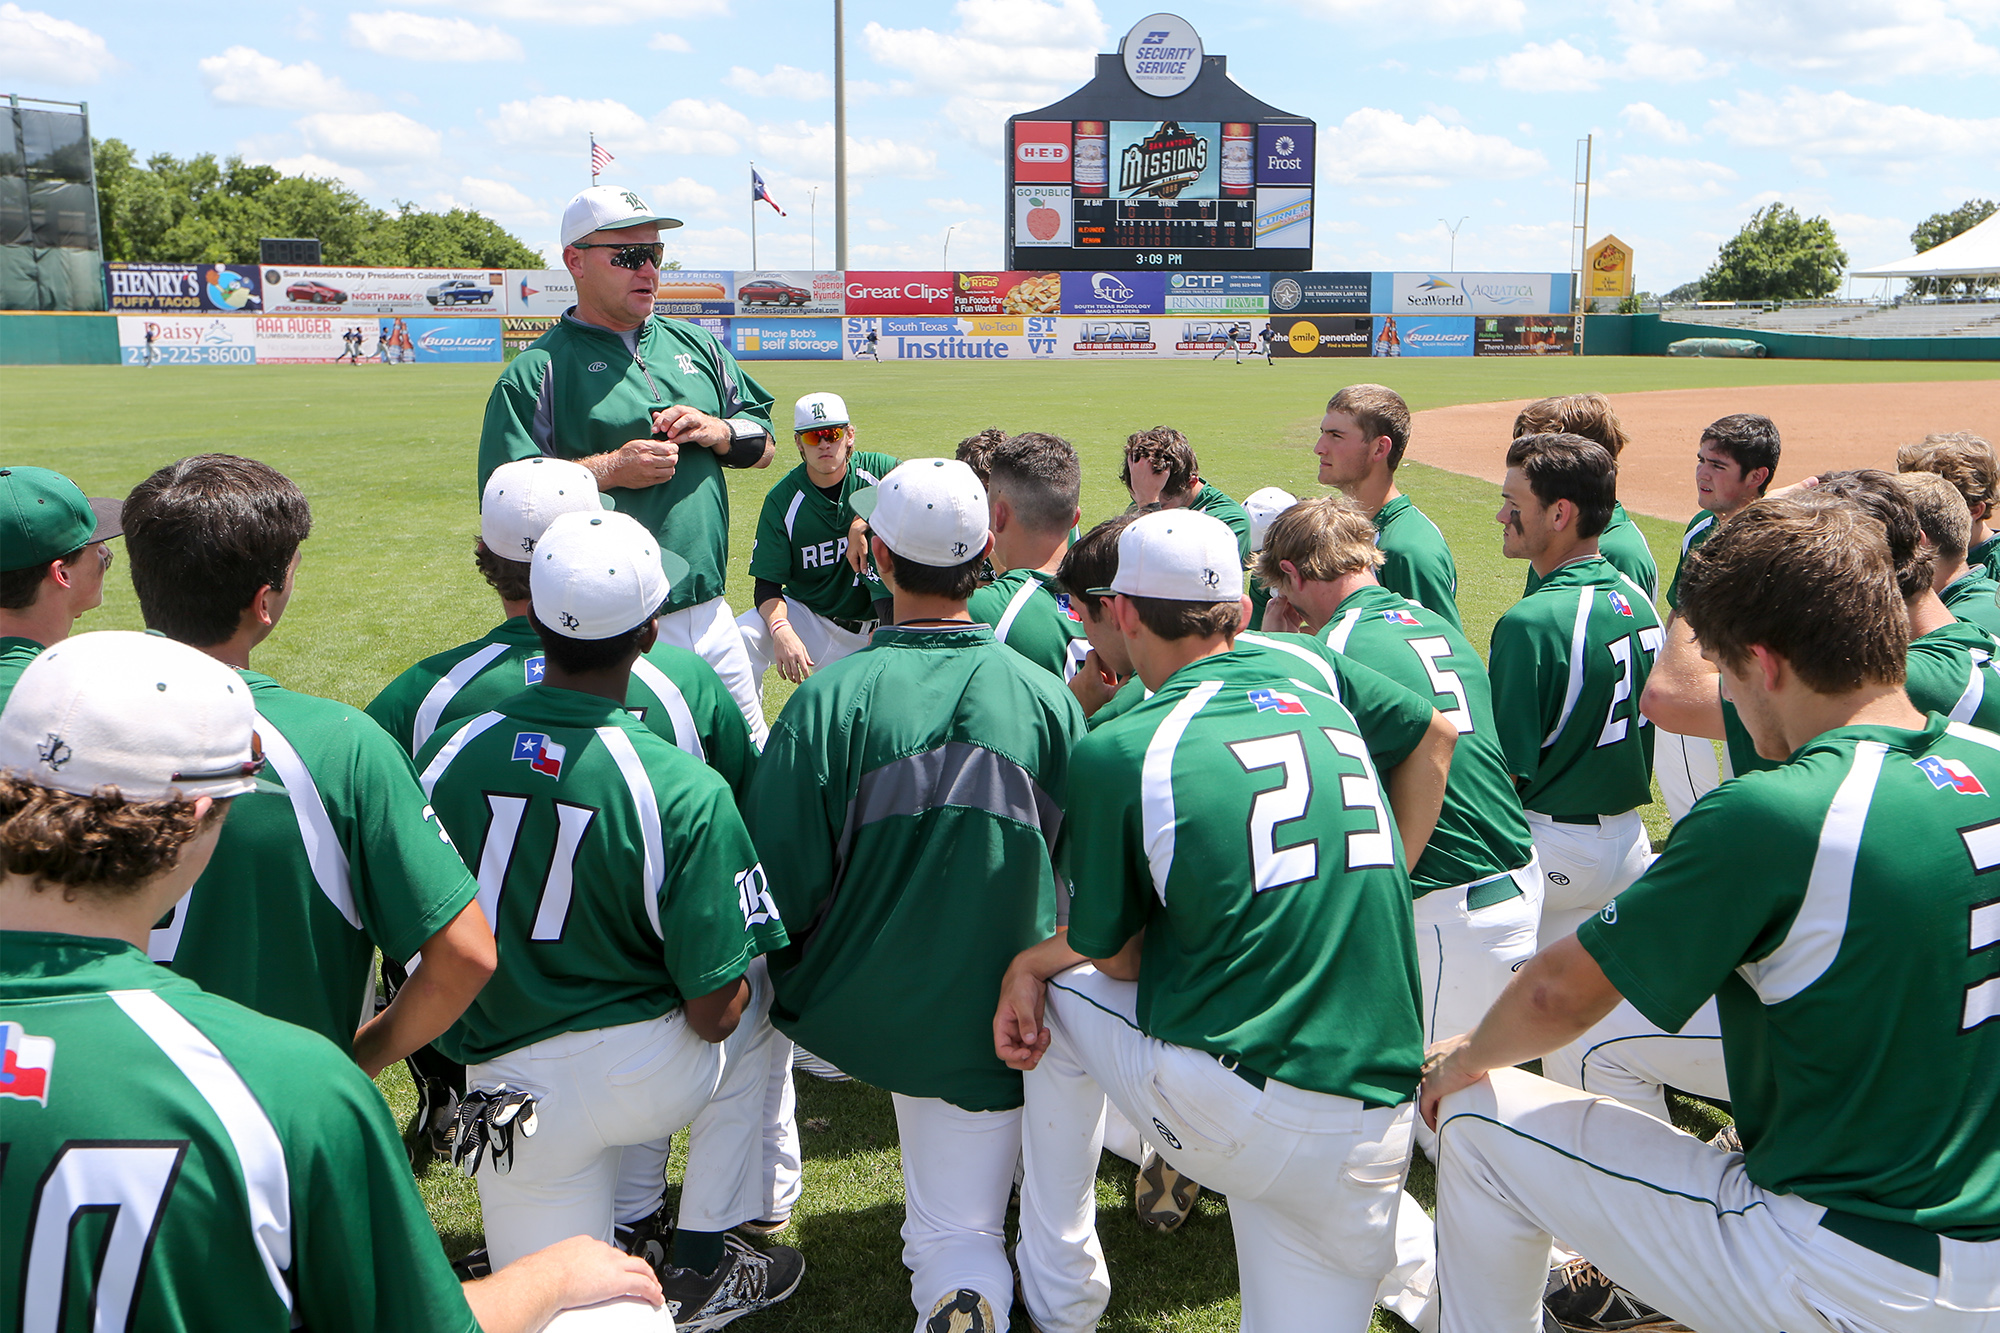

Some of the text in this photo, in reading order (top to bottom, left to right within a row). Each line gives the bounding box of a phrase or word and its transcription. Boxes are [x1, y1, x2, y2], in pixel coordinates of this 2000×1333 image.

[1136, 48, 1196, 60] SECURITY
[1136, 62, 1186, 74] SERVICE
[1149, 138, 1192, 150] SAN ANTONIO
[1122, 140, 1206, 188] MISSIONS
[1268, 156, 1302, 169] Frost
[620, 191, 648, 212] R
[1258, 204, 1309, 228] CORNER
[1136, 254, 1182, 265] 3:09 PM
[110, 270, 199, 296] HENRY'S
[813, 280, 843, 290] Superior
[1186, 275, 1224, 287] CTP
[813, 291, 842, 300] Hyundai
[846, 283, 949, 303] Great Clips
[1094, 286, 1134, 299] stric
[1472, 285, 1533, 297] AQUATICA
[113, 296, 200, 307] PUFFY TACOS
[1173, 297, 1264, 308] RENNERT TRAVEL
[1407, 295, 1463, 306] SeaWorld
[672, 304, 702, 314] BAIRD'S
[256, 318, 331, 333] AAA AUGER
[848, 317, 877, 333] ST
[888, 322, 1017, 331] South Texas Vo-Tech
[1028, 317, 1056, 332] ST
[144, 322, 204, 344] Daisy
[791, 329, 816, 338] Bob's
[1081, 322, 1150, 342] IPAC
[1274, 332, 1367, 344] the smile generation
[424, 337, 496, 346] BUD LIGHT
[762, 339, 838, 352] self storage
[898, 337, 1008, 358] Institute
[1028, 339, 1056, 354] VT
[128, 347, 251, 363] 210-225-8600
[674, 353, 699, 375] R
[812, 402, 827, 421] R
[1404, 634, 1475, 735] 5
[1225, 726, 1396, 898] 23
[474, 789, 600, 945] 11
[734, 862, 780, 932] R
